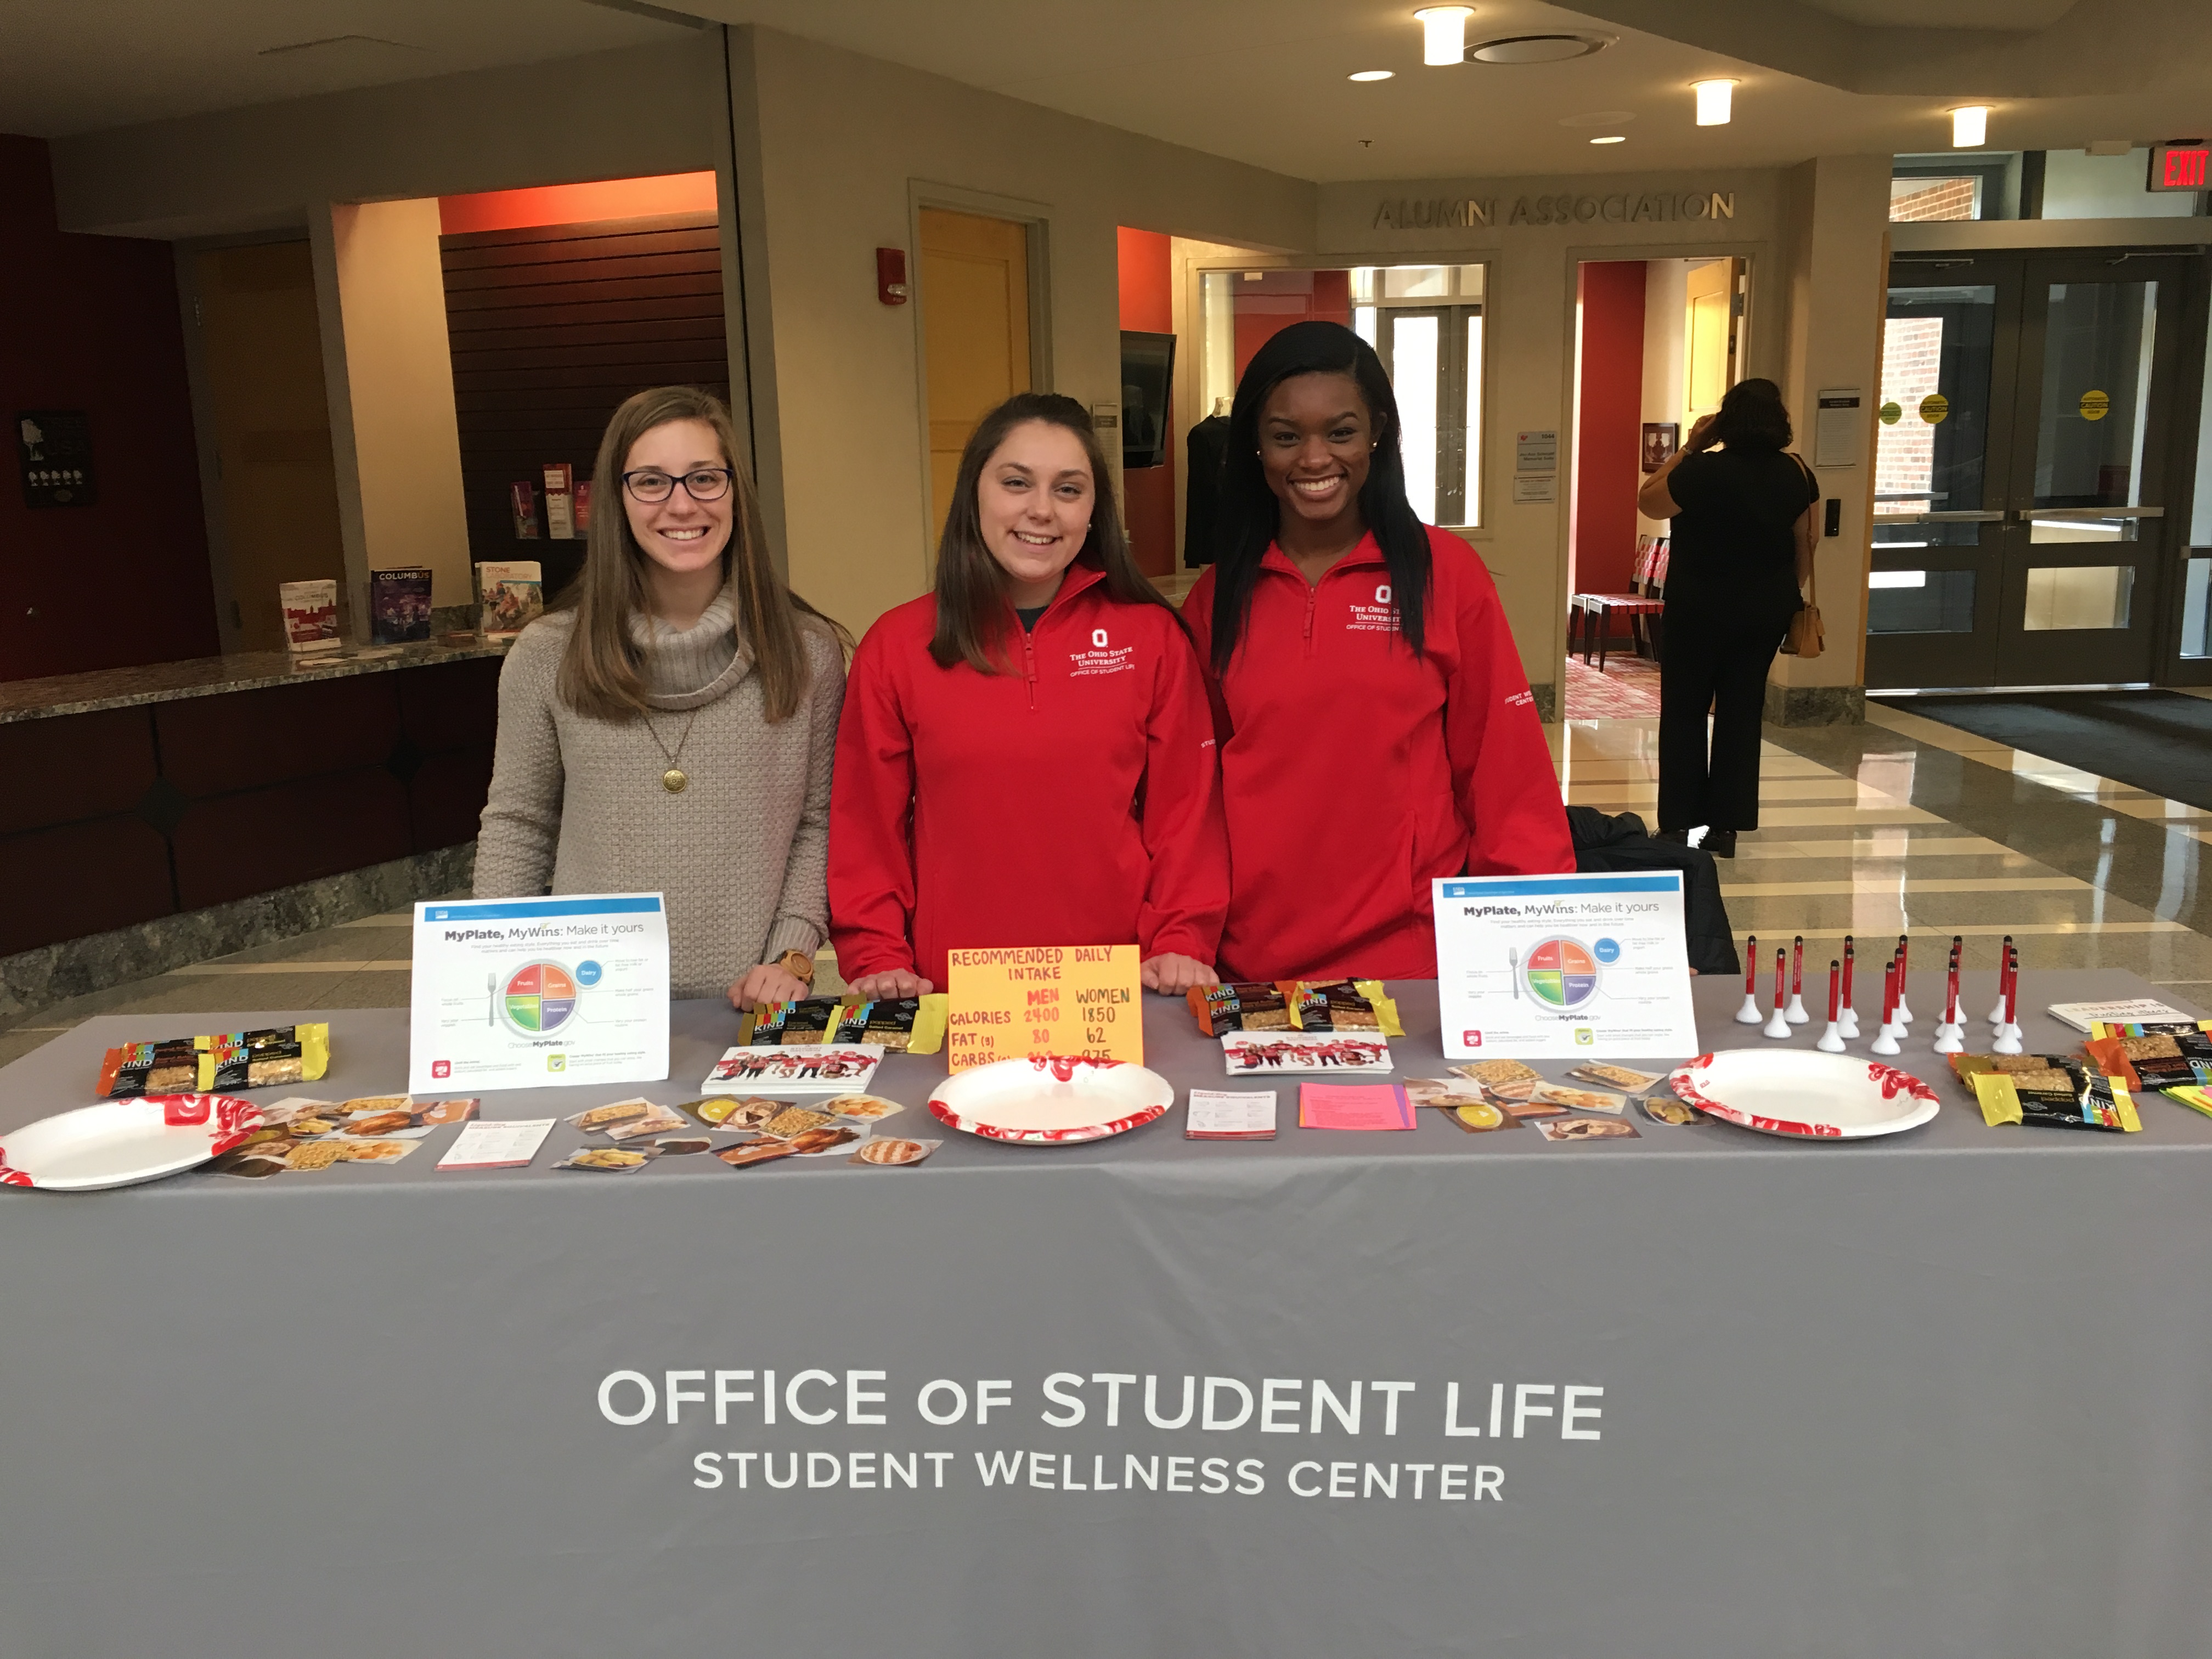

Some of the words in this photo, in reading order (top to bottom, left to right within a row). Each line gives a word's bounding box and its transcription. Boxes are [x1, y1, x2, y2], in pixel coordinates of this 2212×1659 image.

[2164, 150, 2209, 186] EXIT
[1373, 199, 1497, 229] ALUMNI
[1510, 193, 1734, 227] ASSOCIATION
[1356, 613, 1401, 622] UNIVERSIT
[1078, 656, 1126, 667] UNIVERSITY
[1099, 665, 1124, 674] STUDENT
[1464, 906, 1521, 917] MyPlate,
[1525, 905, 1578, 917] MyWins:
[1581, 904, 1612, 913] Make
[1615, 902, 1623, 912] it
[1626, 903, 1660, 914] yours
[444, 929, 504, 943] MyPlate,
[508, 927, 563, 940] MyWins:
[566, 924, 597, 935] Make
[601, 924, 608, 934] it
[611, 924, 644, 938] yours
[952, 948, 1063, 967] RECOMMENDED
[1075, 946, 1113, 962] DAILY
[1008, 966, 1062, 980] INTAKE
[1027, 988, 1059, 1006] MEN
[1076, 987, 1130, 1004] WOMEN
[1205, 989, 1235, 1002] KIND
[1210, 1003, 1240, 1016] KIND
[1298, 998, 1328, 1009] KIND
[2064, 1003, 2147, 1013] LEADERSHIP
[950, 1011, 1011, 1026] CALORIES
[1024, 1007, 1059, 1023] 2400
[1082, 1007, 1116, 1023] 1850
[754, 1021, 785, 1031] KIND
[952, 1033, 977, 1047] FAT
[1034, 1029, 1049, 1043] 80
[1087, 1028, 1106, 1043] 62
[216, 1055, 249, 1071] KIND
[952, 1052, 995, 1066] CARBS
[599, 1370, 886, 1425] OFFICE
[918, 1379, 1012, 1425] OF
[1041, 1372, 1415, 1435] STUDENT
[1446, 1382, 1604, 1440] LIFE
[694, 1452, 953, 1488] STUDENT
[975, 1451, 1265, 1495] WELLNESS
[1289, 1461, 1505, 1501] CENTER
